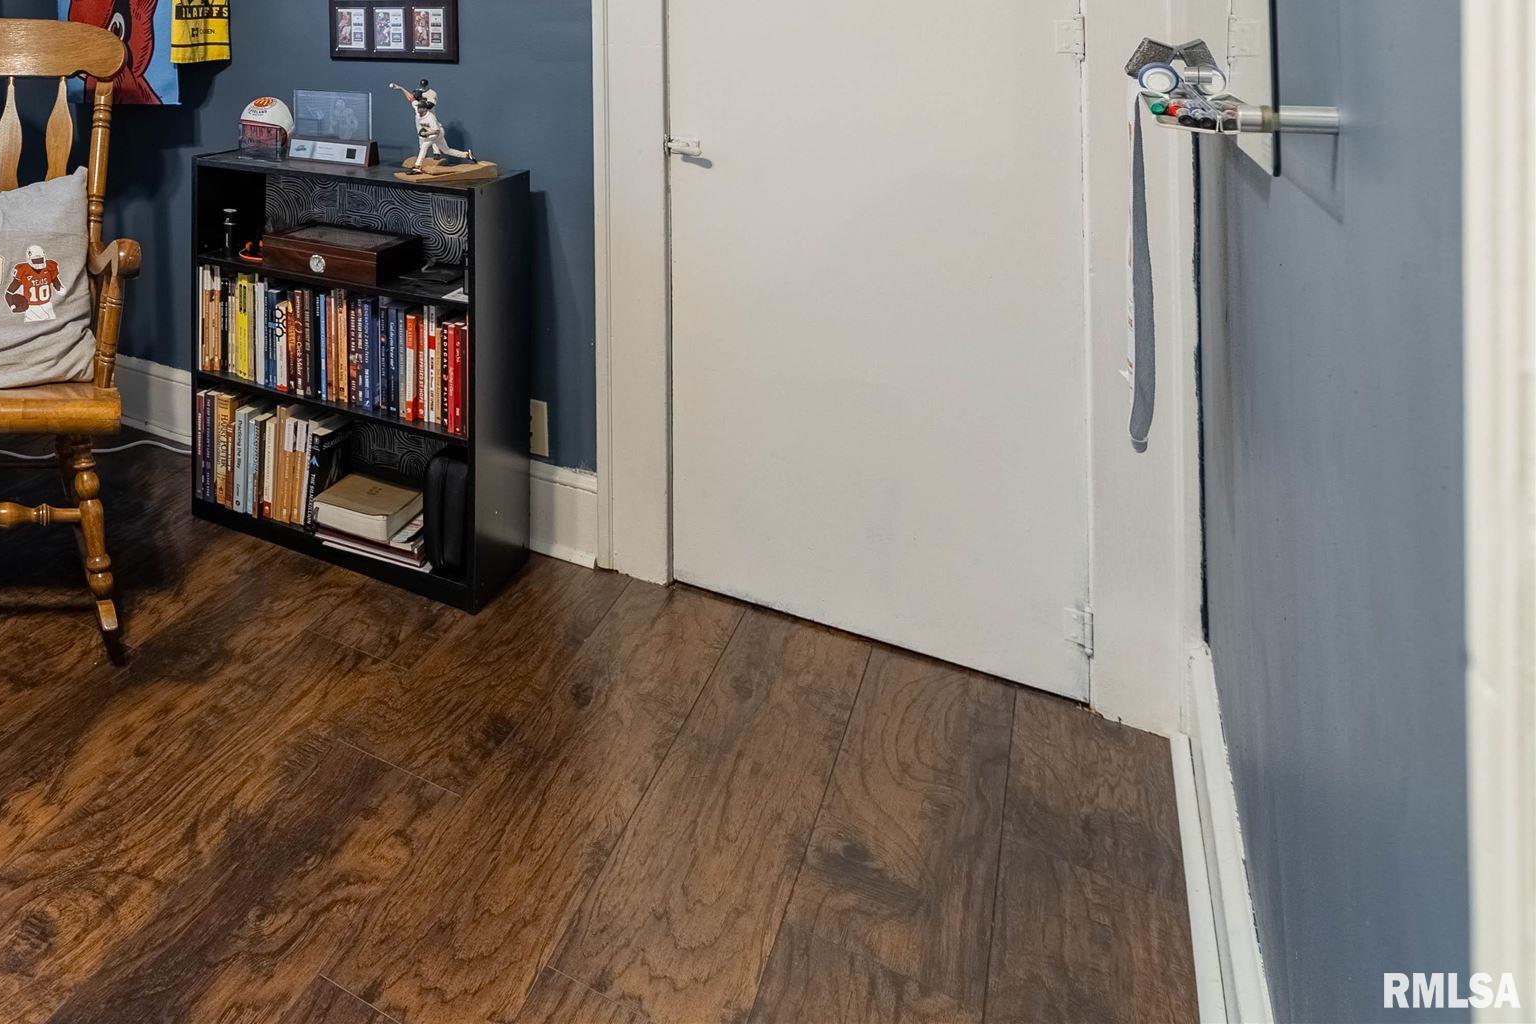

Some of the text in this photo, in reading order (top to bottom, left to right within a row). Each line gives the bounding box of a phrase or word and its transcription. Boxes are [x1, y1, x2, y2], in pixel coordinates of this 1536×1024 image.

[31, 278, 48, 287] TEXAS
[29, 285, 51, 302] 10
[221, 414, 229, 437] HARRY
